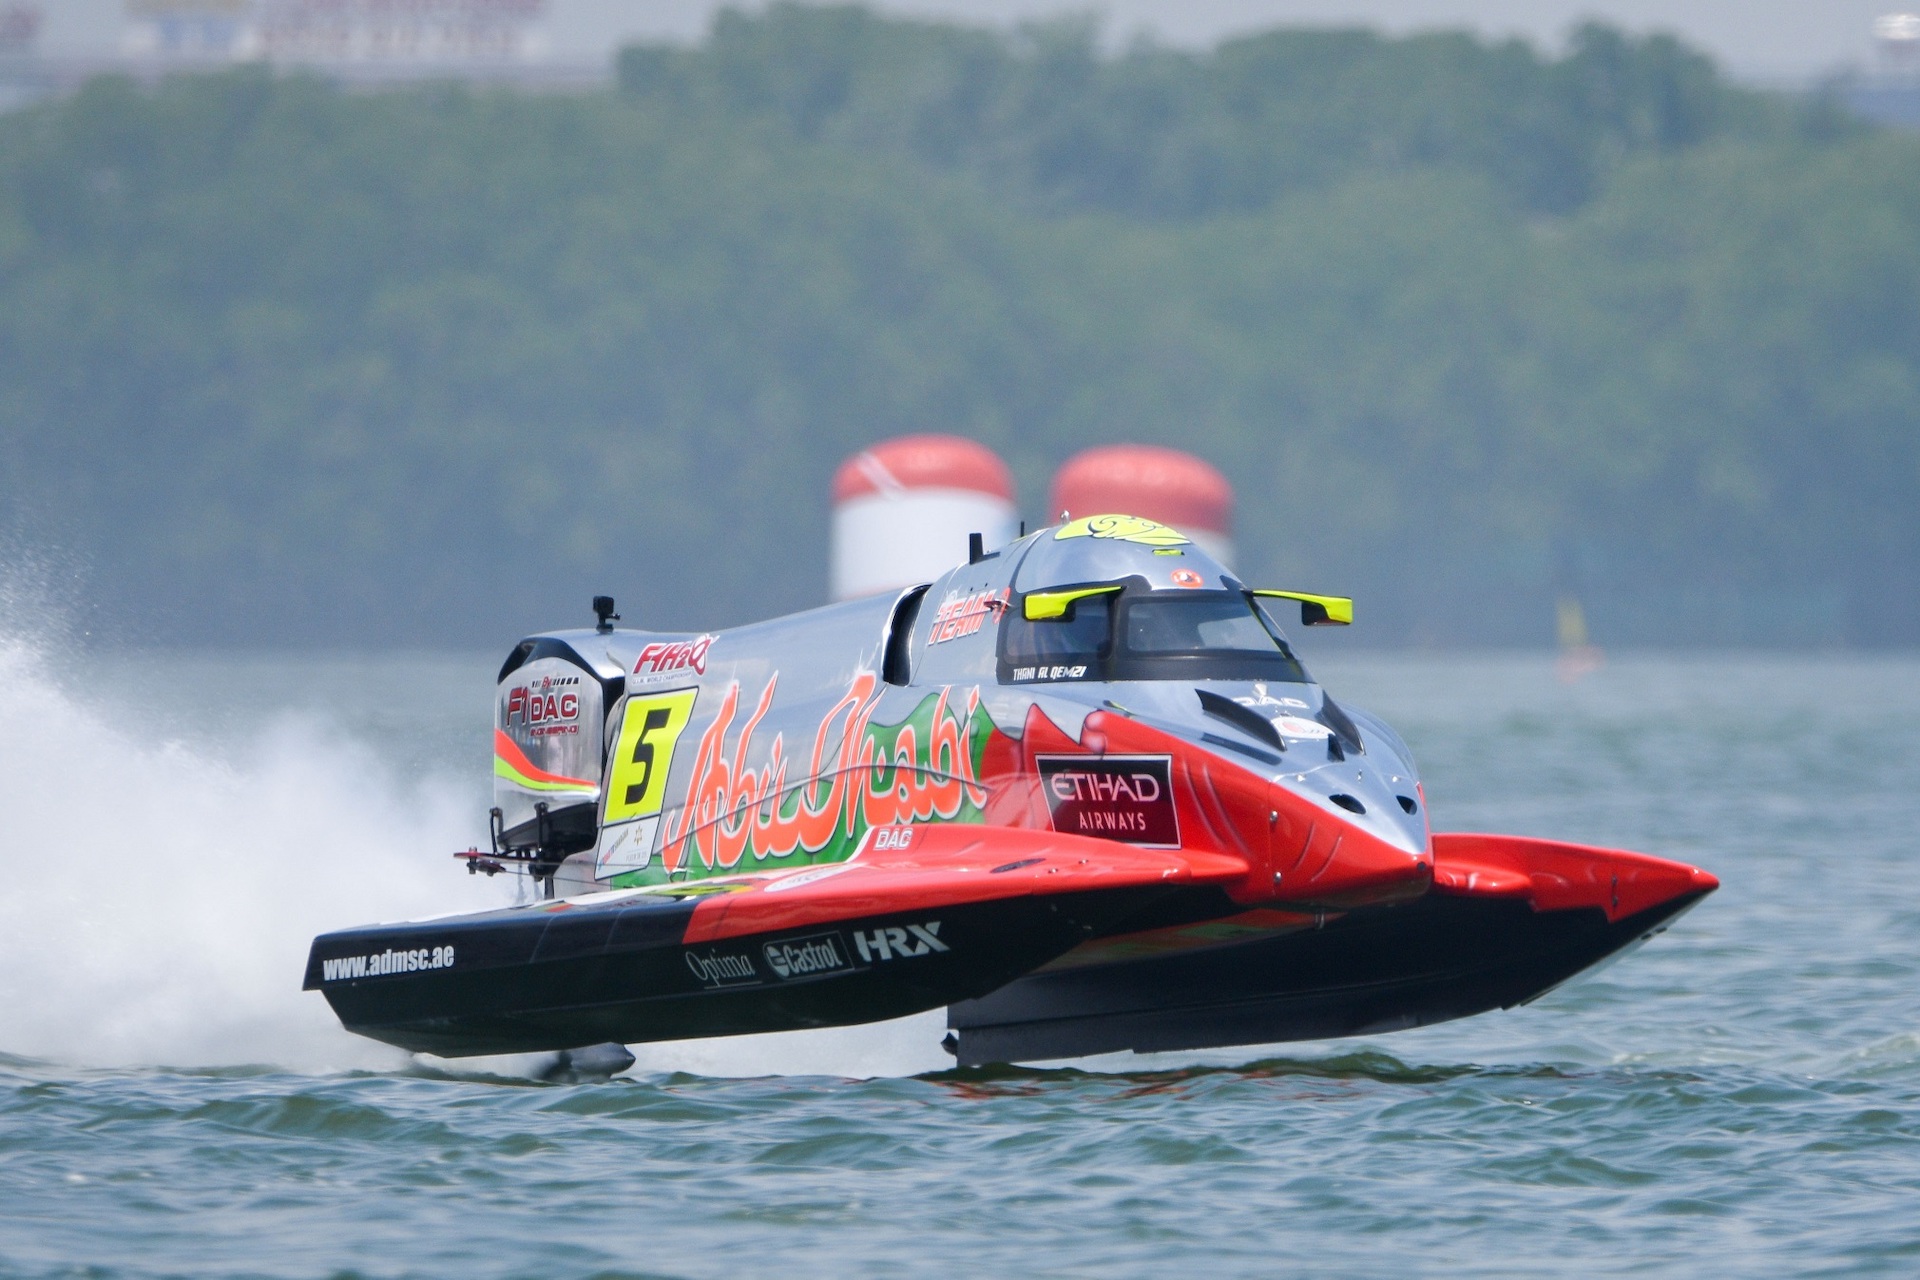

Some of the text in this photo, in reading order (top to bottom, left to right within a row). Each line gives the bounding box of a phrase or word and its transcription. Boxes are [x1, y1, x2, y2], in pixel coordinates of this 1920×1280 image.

[1013, 667, 1036, 681] THANI
[1037, 666, 1049, 679] AL
[530, 692, 579, 723] DAC
[624, 707, 672, 806] 5
[661, 667, 988, 875] Abu Dhabi
[1051, 773, 1160, 802] ETIHAD
[873, 828, 913, 851] DAC
[1079, 812, 1146, 831] AIRWAYS
[782, 938, 843, 976] Castrol
[853, 921, 950, 962] HRX
[323, 945, 455, 981] www.admsc.ae
[685, 948, 756, 988] Optima
